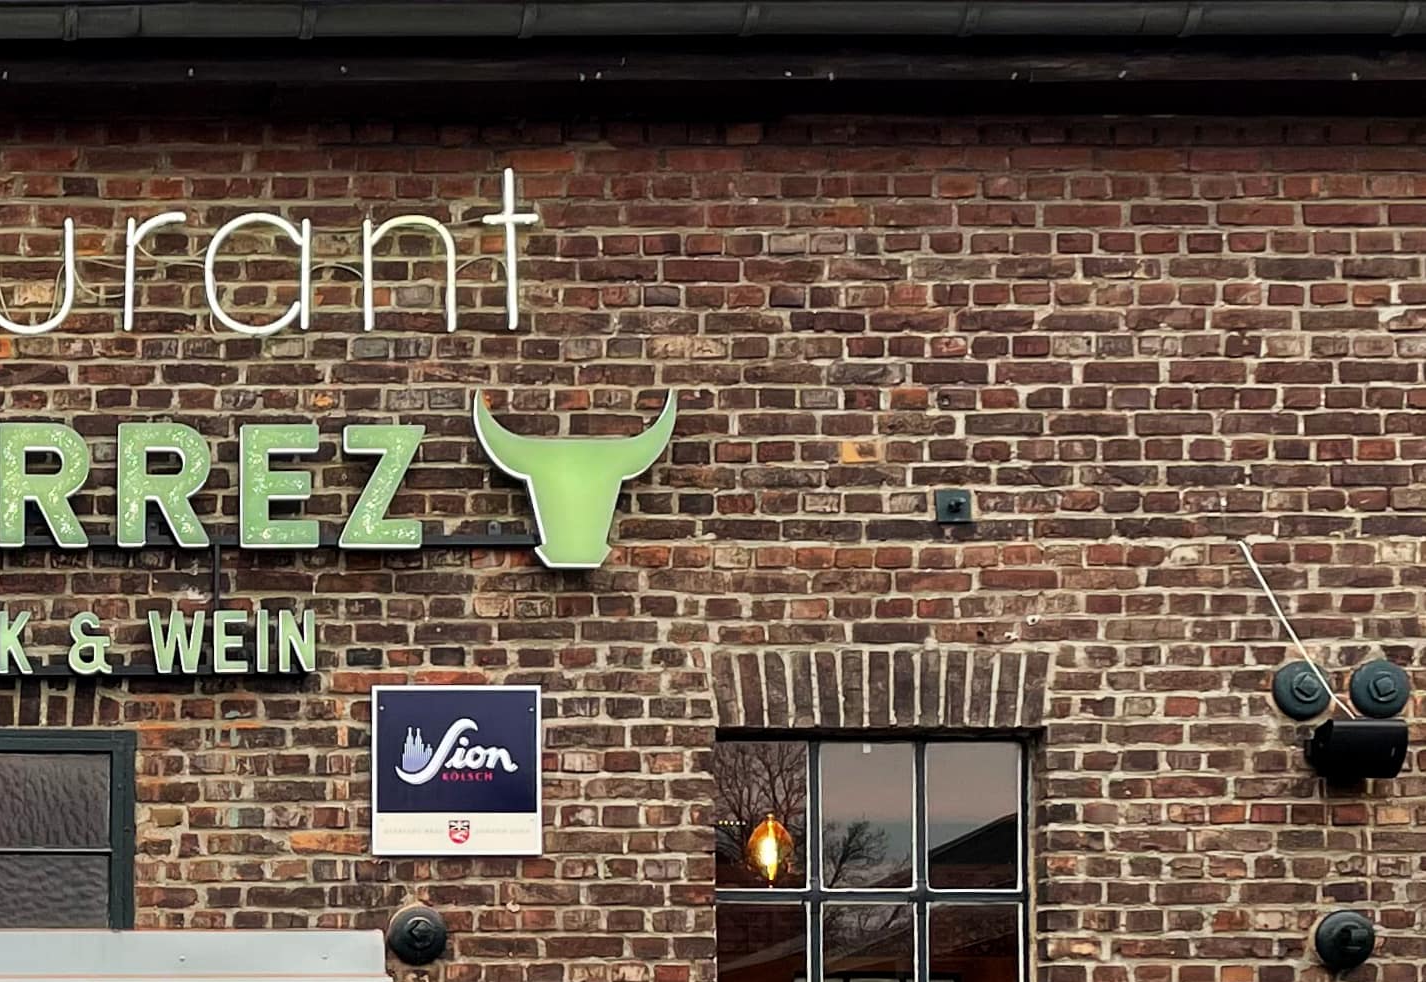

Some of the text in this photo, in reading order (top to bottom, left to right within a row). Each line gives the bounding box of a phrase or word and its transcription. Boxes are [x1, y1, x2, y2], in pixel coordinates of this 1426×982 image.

[68, 610, 113, 675] &
[148, 609, 317, 675] WEIN
[394, 717, 519, 786] Sion
